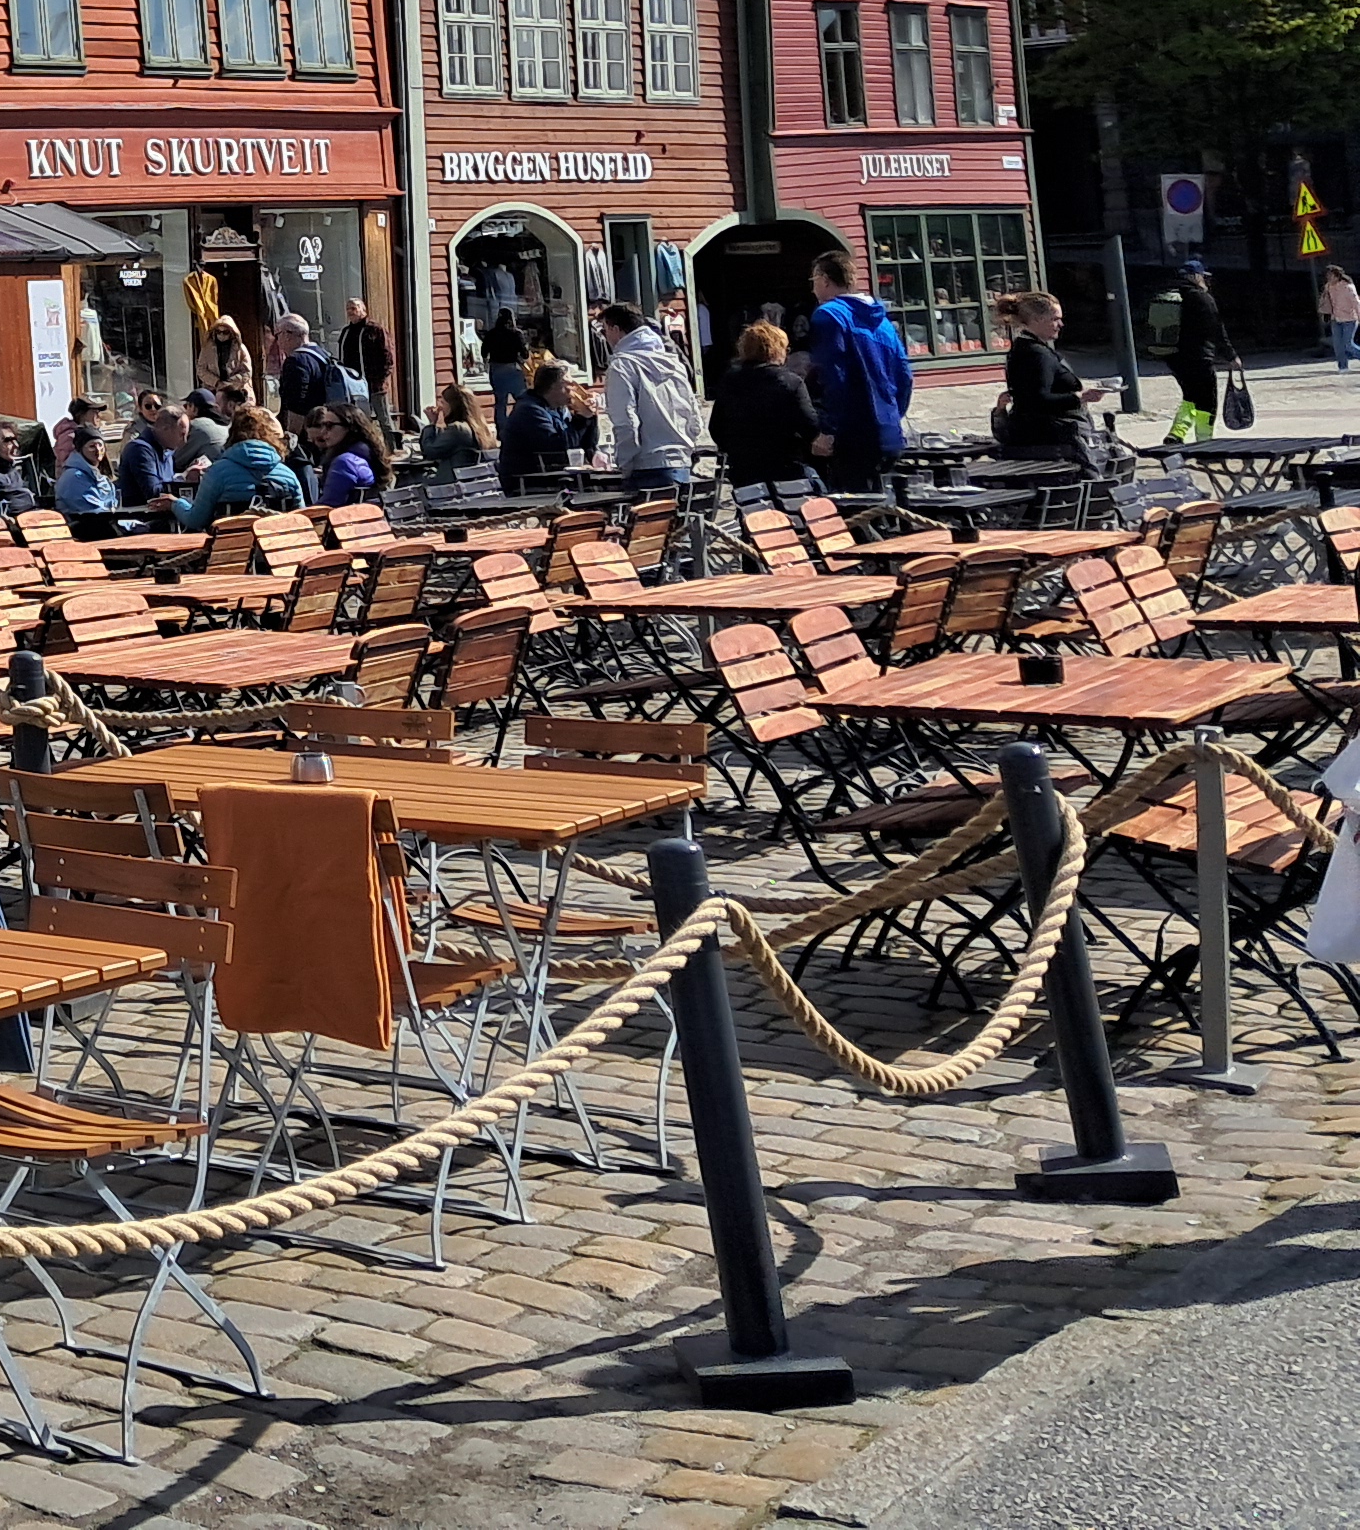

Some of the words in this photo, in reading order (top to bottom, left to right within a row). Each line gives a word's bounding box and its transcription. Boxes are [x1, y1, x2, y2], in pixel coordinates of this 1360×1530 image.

[25, 137, 124, 179] KNUT
[144, 137, 331, 177] SKURTVEIT
[442, 150, 551, 183] BRYGGEN
[557, 151, 653, 183] HUSFLID
[859, 153, 952, 186] JULEHUSET
